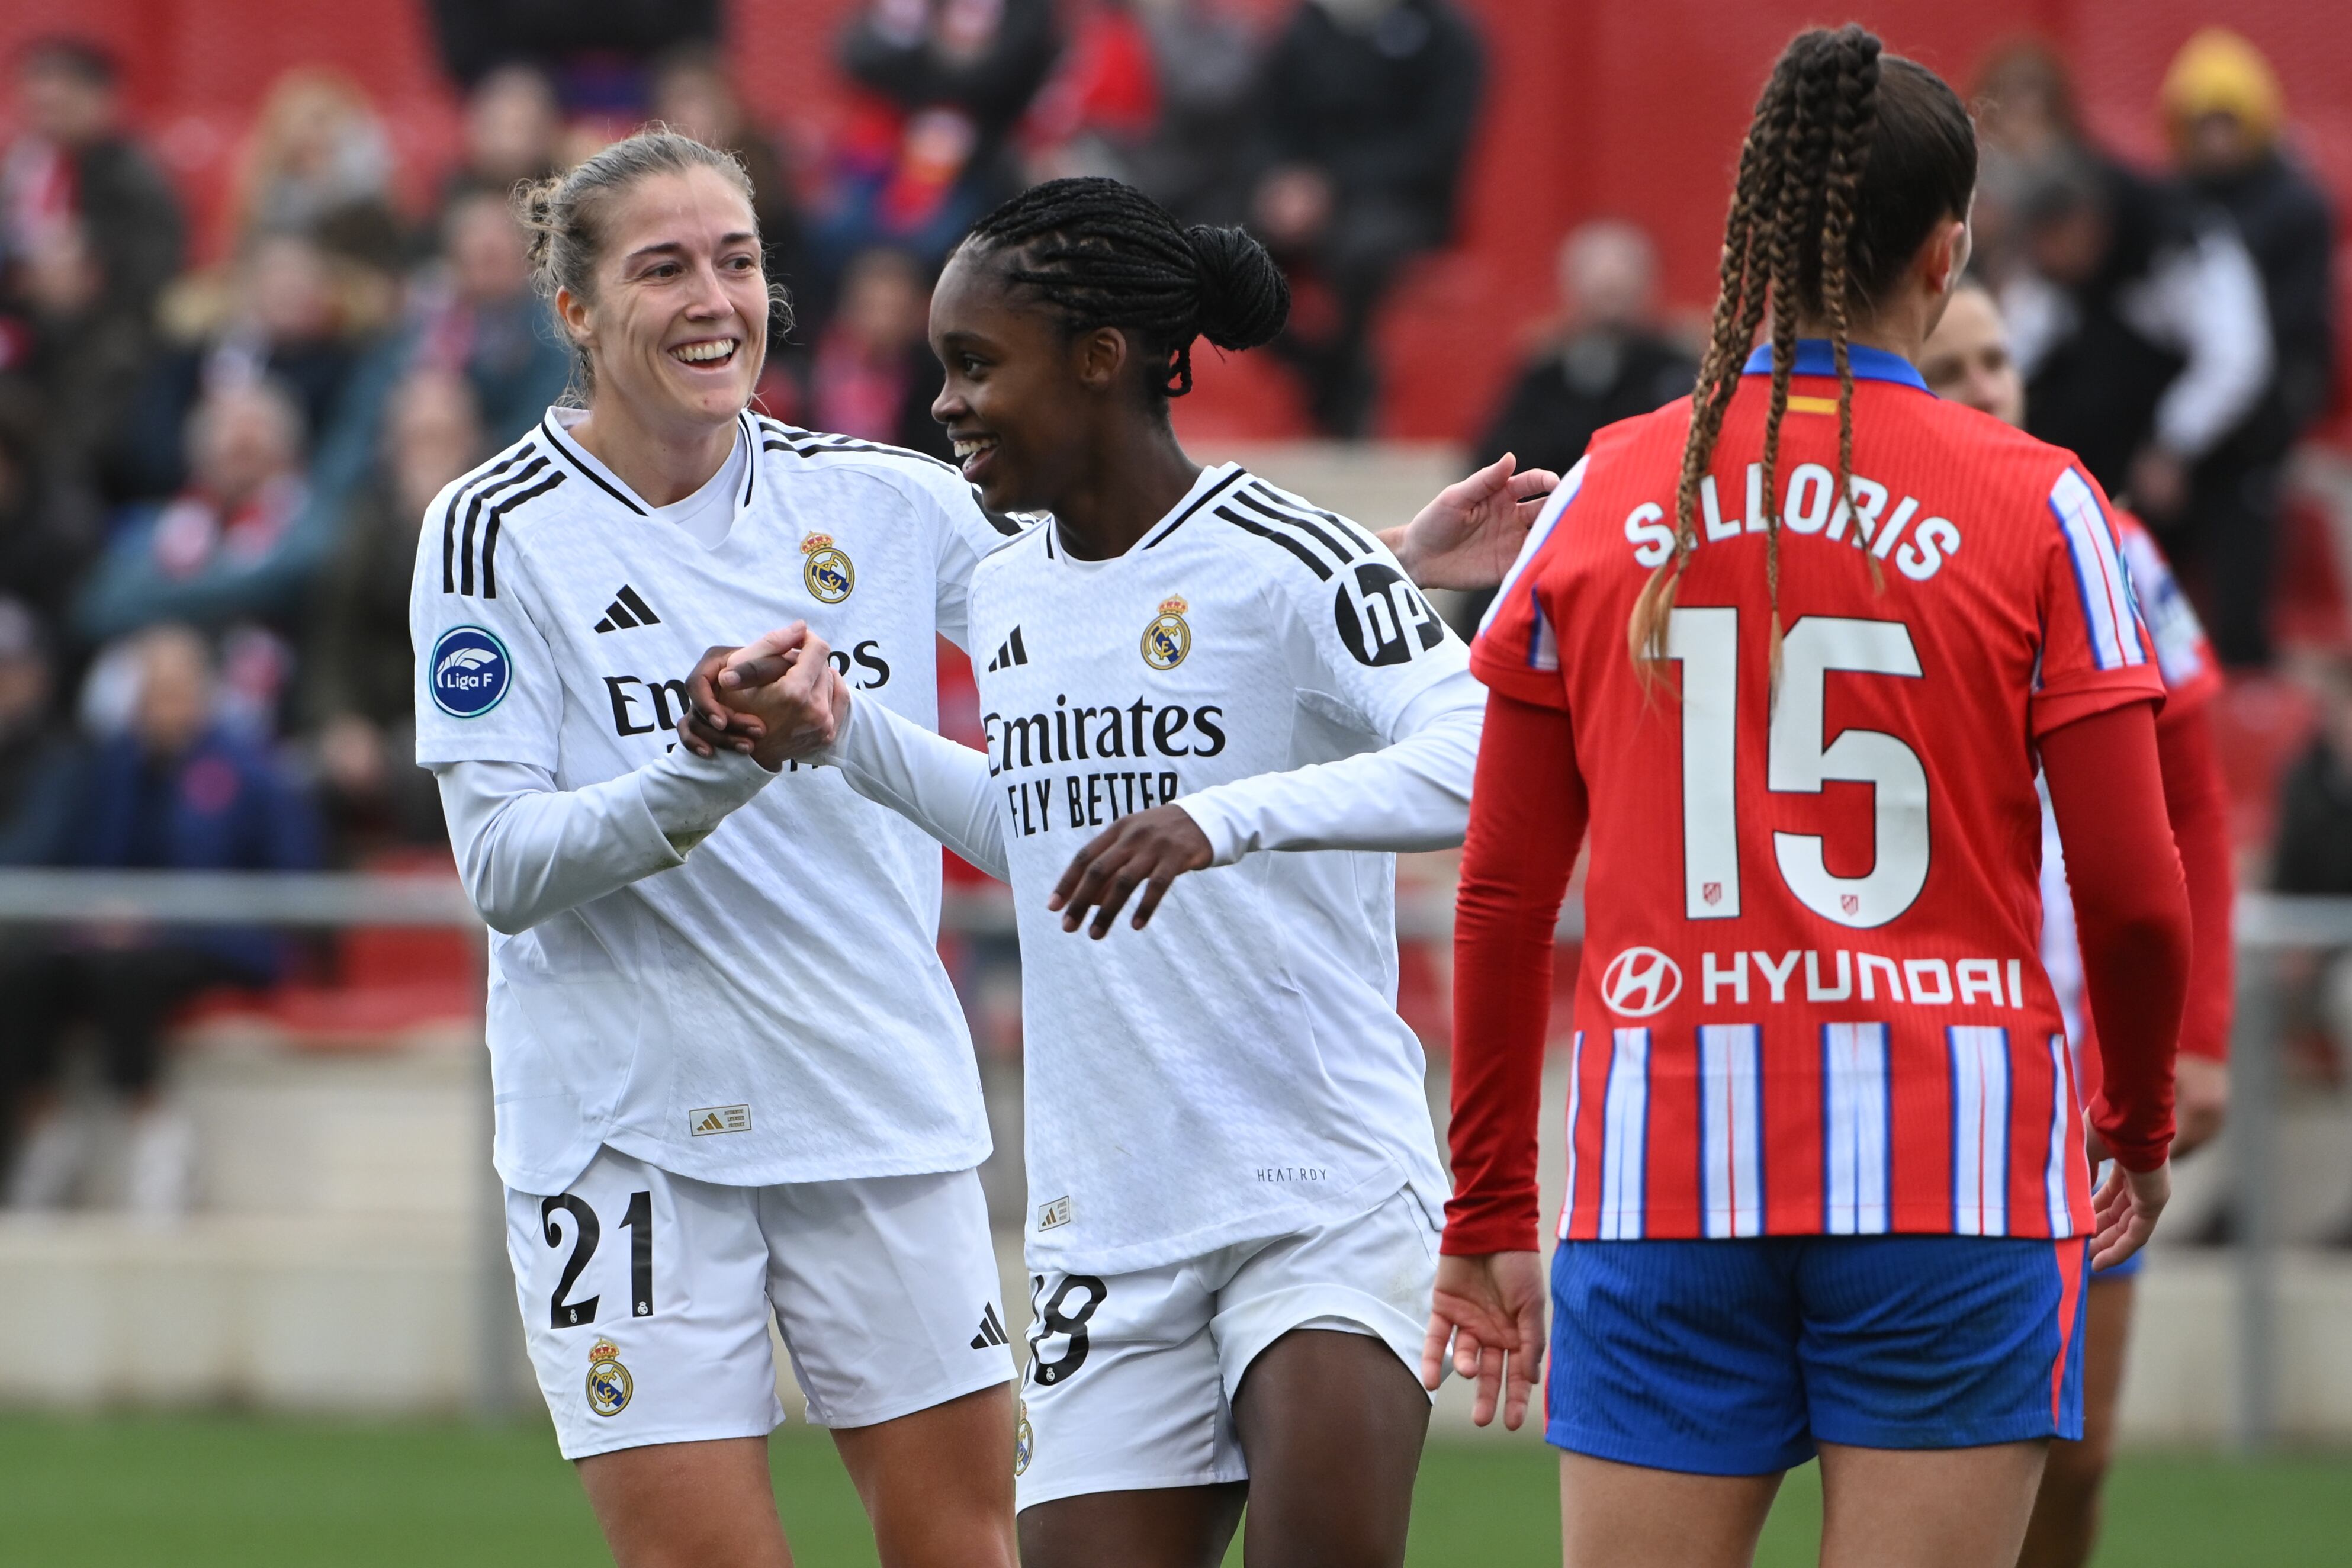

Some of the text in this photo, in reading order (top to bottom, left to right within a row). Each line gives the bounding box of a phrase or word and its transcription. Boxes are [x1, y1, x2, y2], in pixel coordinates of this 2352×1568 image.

[1335, 563, 1444, 667] hp
[447, 673, 493, 691] Liga F
[984, 694, 1226, 778] Emirates
[1637, 606, 1930, 929] 15
[1008, 772, 1178, 838] FLY BETTER
[1702, 950, 2023, 1009] HYUNDAI
[1257, 1168, 1326, 1182] HEAT.RDY
[541, 1191, 653, 1329] 21
